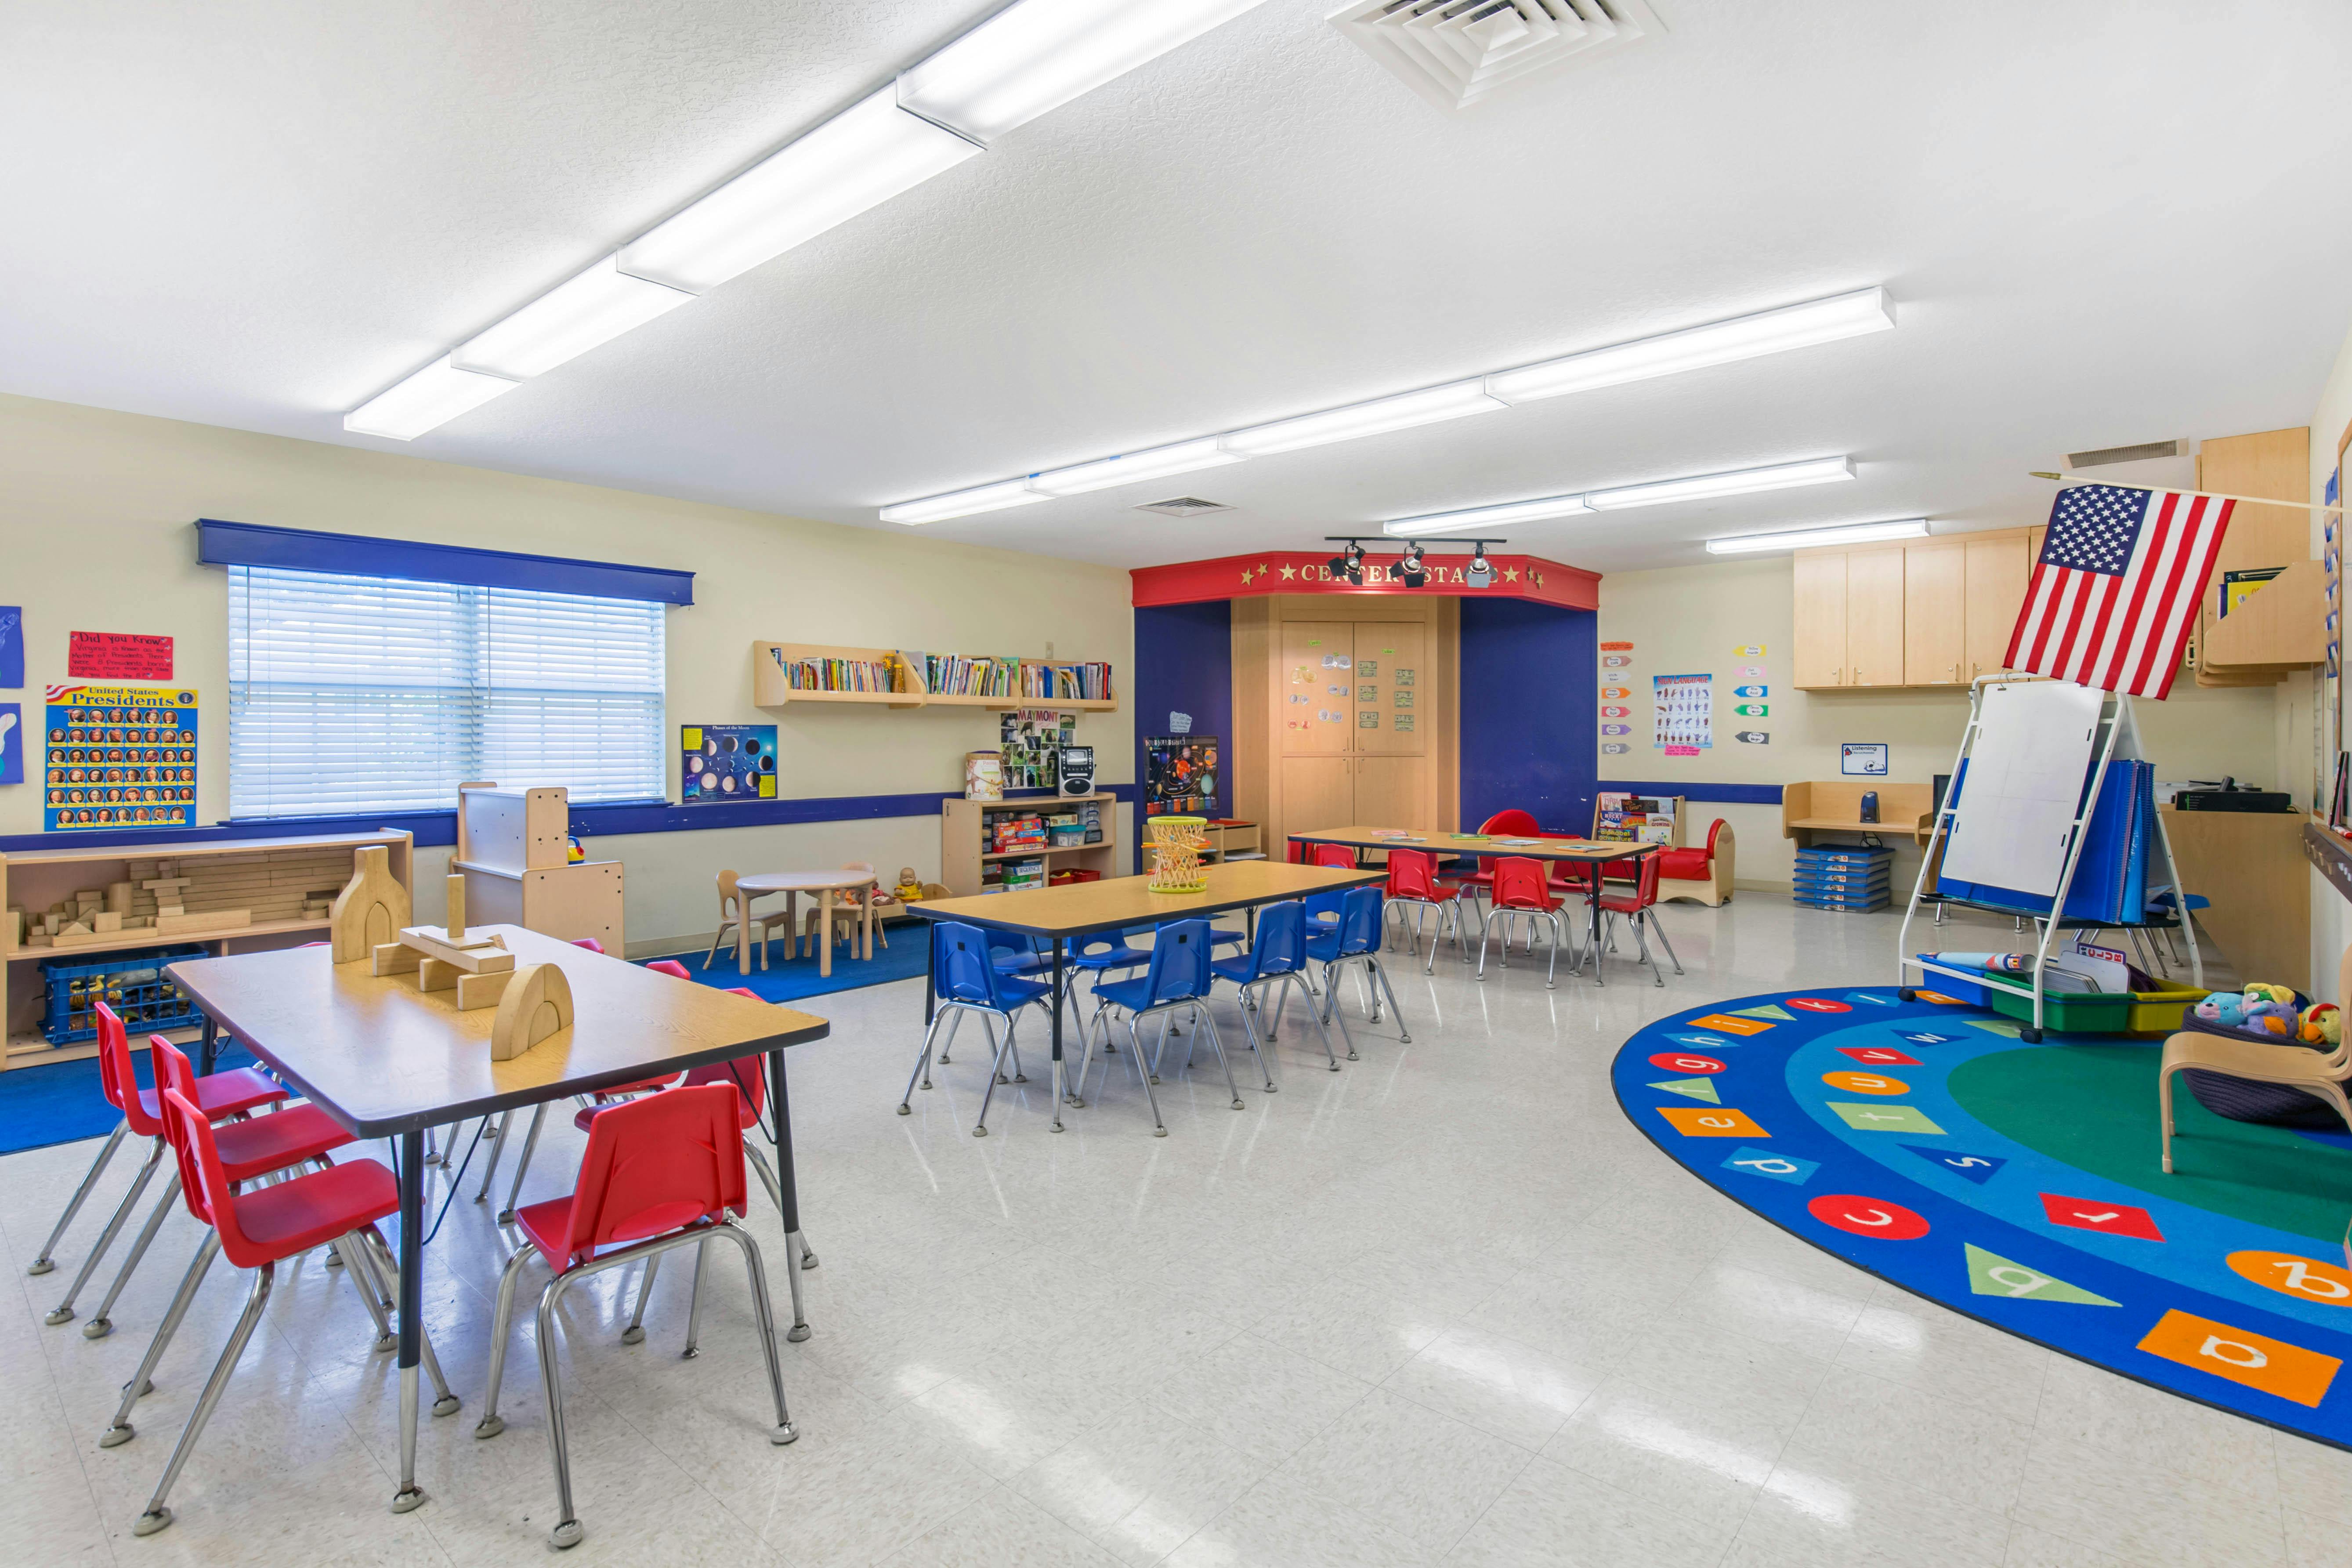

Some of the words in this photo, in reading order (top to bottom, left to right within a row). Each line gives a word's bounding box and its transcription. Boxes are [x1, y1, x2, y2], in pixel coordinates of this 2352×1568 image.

[80, 633, 101, 643] Did
[133, 635, 161, 645] Know
[76, 644, 106, 653] Virginia
[72, 694, 174, 706] Presidents
[1018, 710, 1058, 722] MAYMONT
[2088, 948, 2122, 963] CLUB
[1805, 1000, 1837, 1009] k
[1680, 1032, 1725, 1046] h
[1905, 1033, 1947, 1043] w
[1863, 1051, 1897, 1060] v
[1675, 1058, 1719, 1070] g
[1661, 1083, 1710, 1094] f
[1851, 1077, 1887, 1088] u
[1698, 1116, 1735, 1128] e
[1859, 1112, 1903, 1121] t
[1733, 1159, 1797, 1173] d
[1945, 1157, 1991, 1168] s
[1844, 1209, 1892, 1226] c
[2073, 1212, 2120, 1222] r
[1988, 1266, 2053, 1296] b
[2272, 1261, 2351, 1299] q
[2199, 1335, 2267, 1368] a
